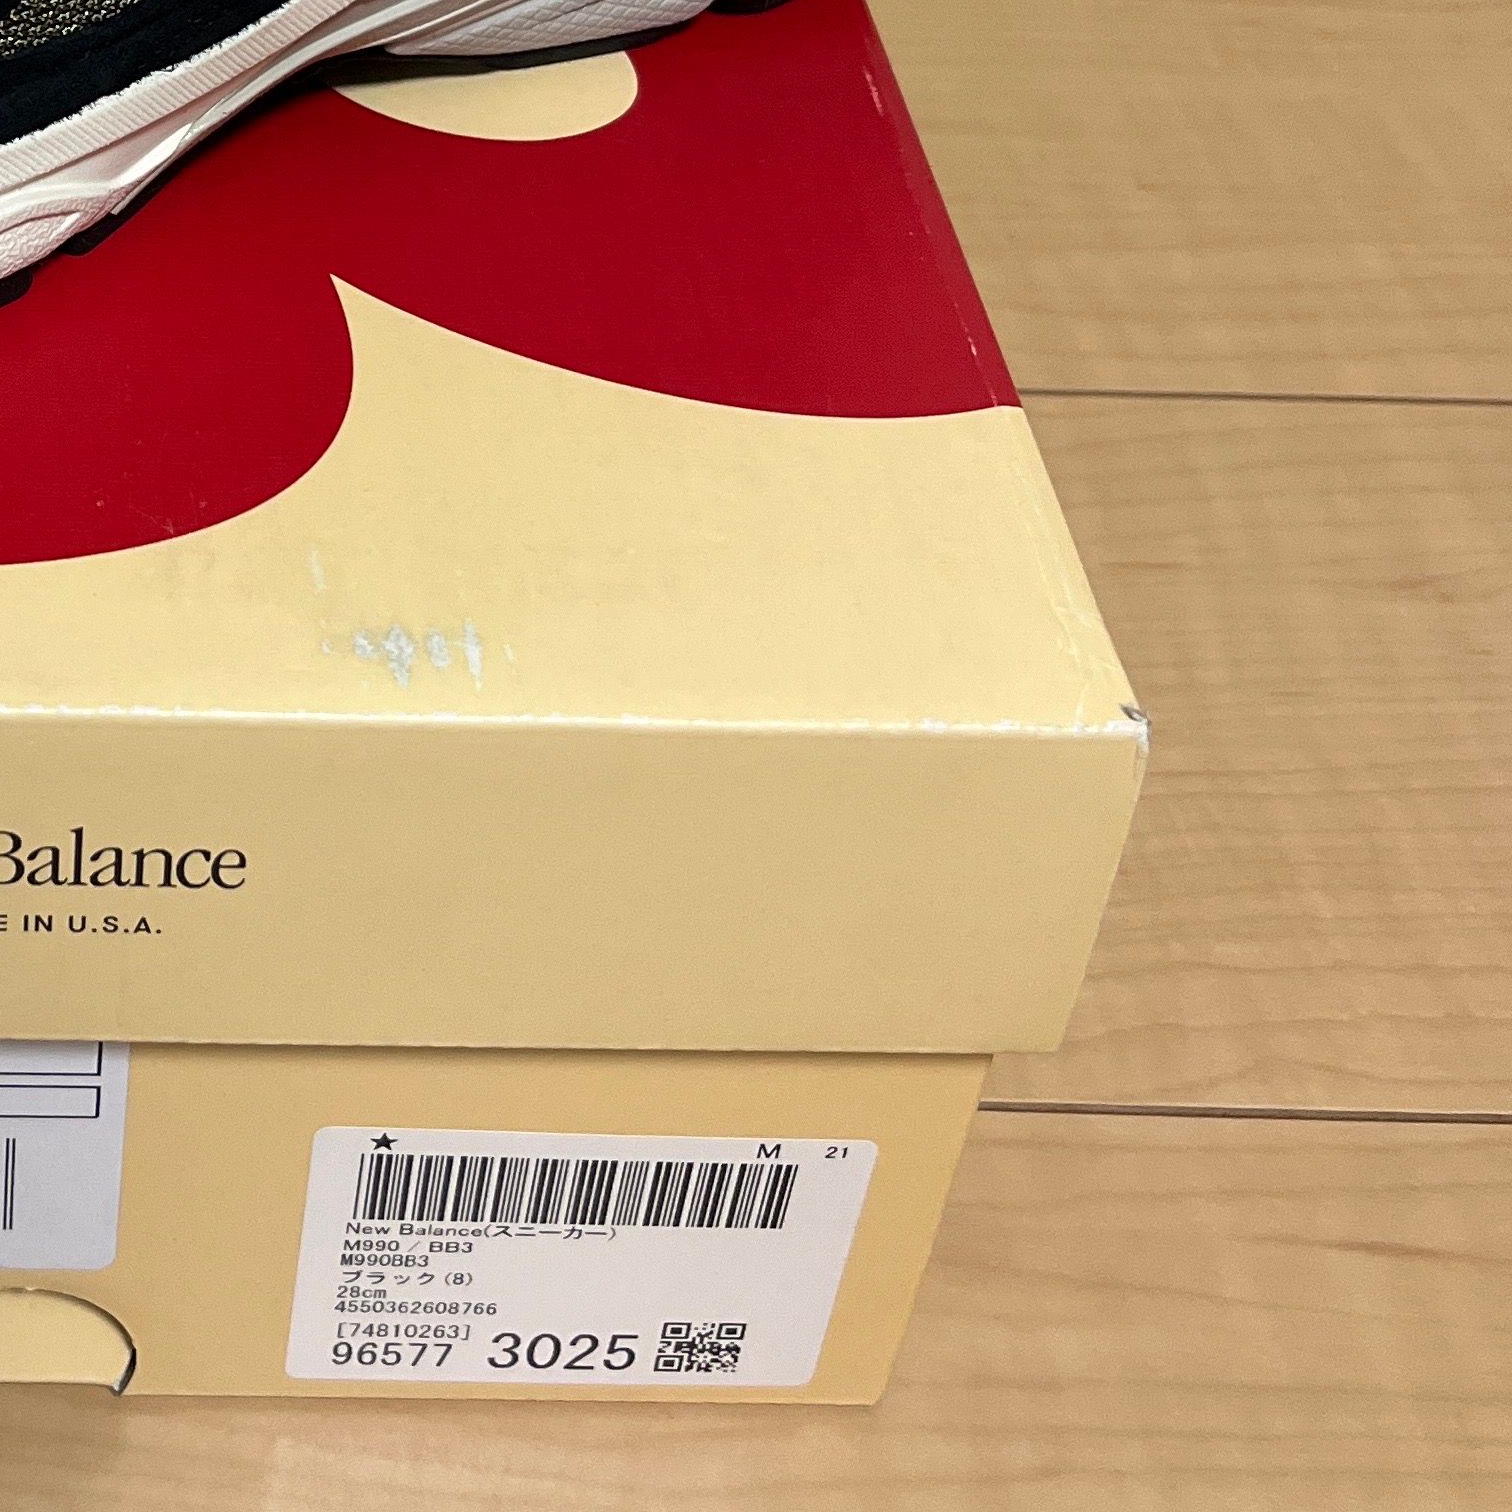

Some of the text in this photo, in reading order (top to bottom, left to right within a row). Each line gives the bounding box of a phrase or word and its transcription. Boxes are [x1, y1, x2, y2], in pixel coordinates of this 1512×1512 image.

[23, 914, 53, 932] IN
[68, 915, 163, 935] U.S.A.
[756, 1143, 849, 1159] M 21
[345, 1222, 390, 1235] New
[343, 1240, 400, 1252] M990
[428, 1242, 473, 1254] BB3
[340, 1254, 429, 1267] M990BB3
[336, 1286, 387, 1299] 28cm
[334, 1300, 497, 1316] 4550362608766
[337, 1323, 471, 1340] [74810263]
[331, 1333, 639, 1371] 96577 3025
